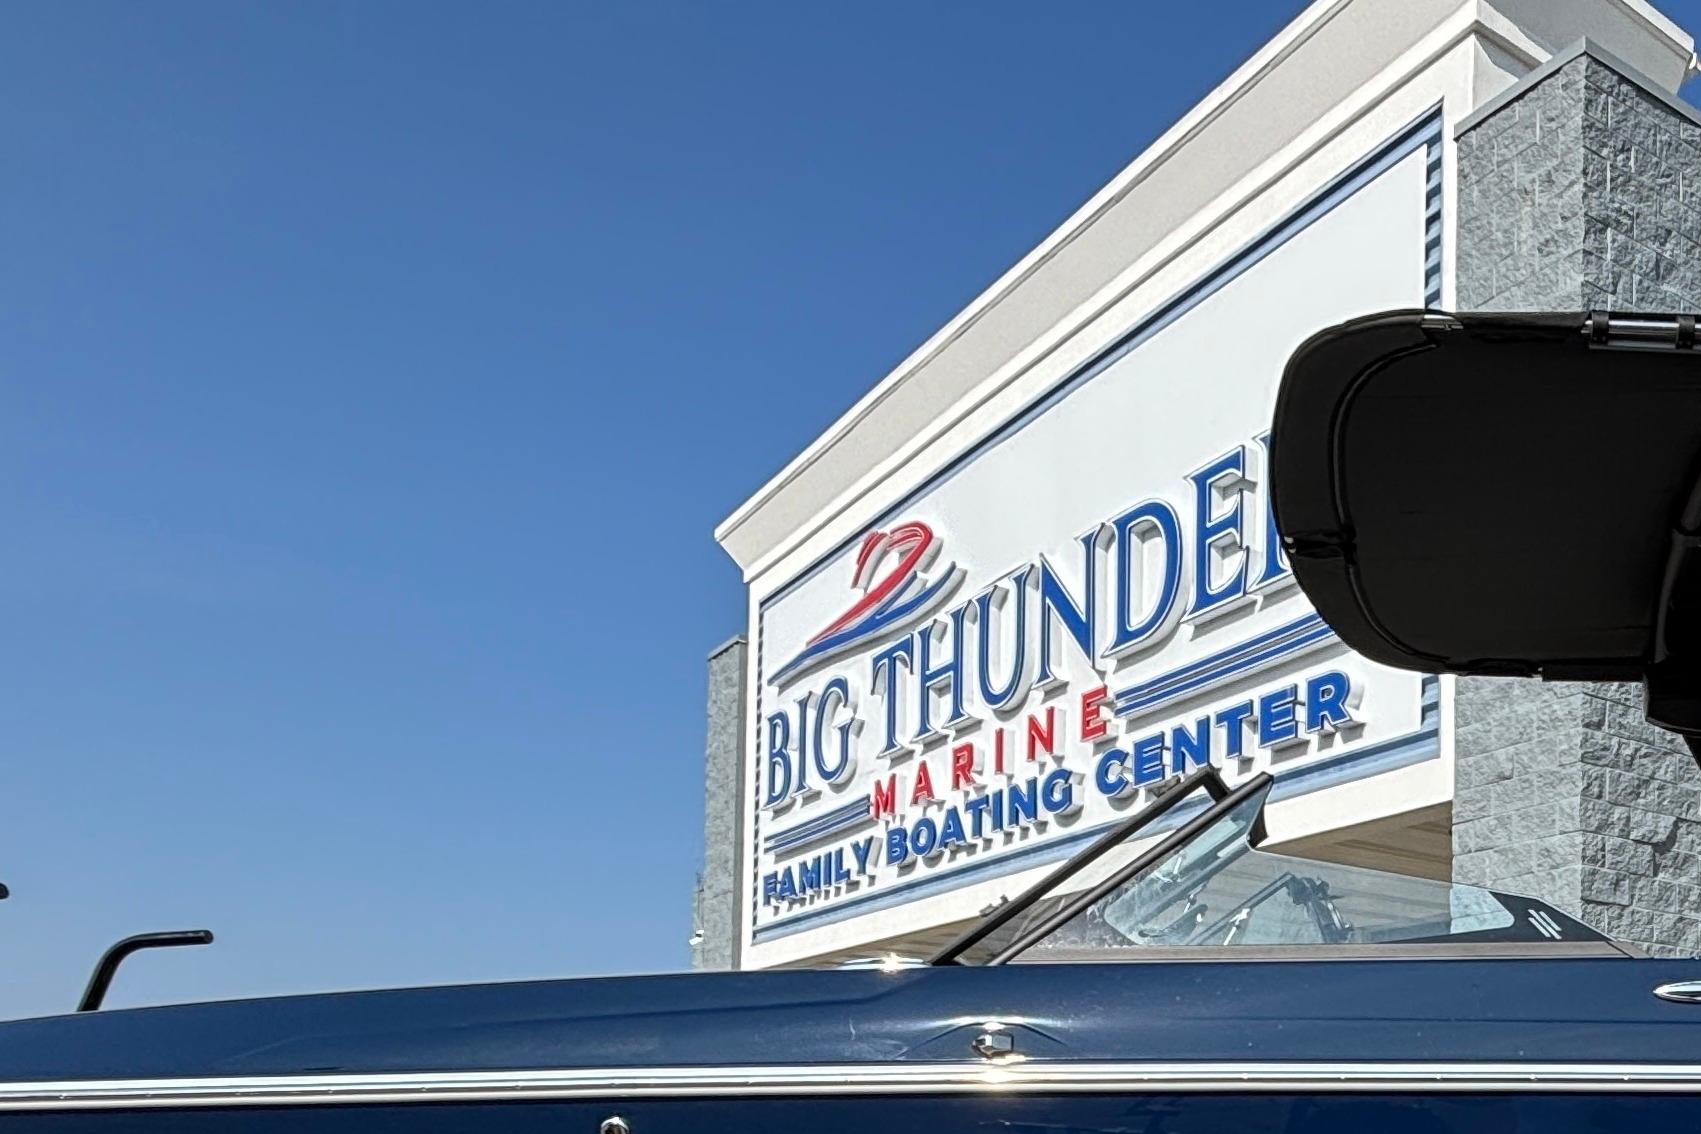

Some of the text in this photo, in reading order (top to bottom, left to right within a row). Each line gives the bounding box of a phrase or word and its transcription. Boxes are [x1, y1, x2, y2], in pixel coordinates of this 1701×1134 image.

[761, 675, 856, 811] BIG
[763, 670, 1353, 906] FAMILY BOATING CENTER
[870, 684, 1108, 821] MARINE
